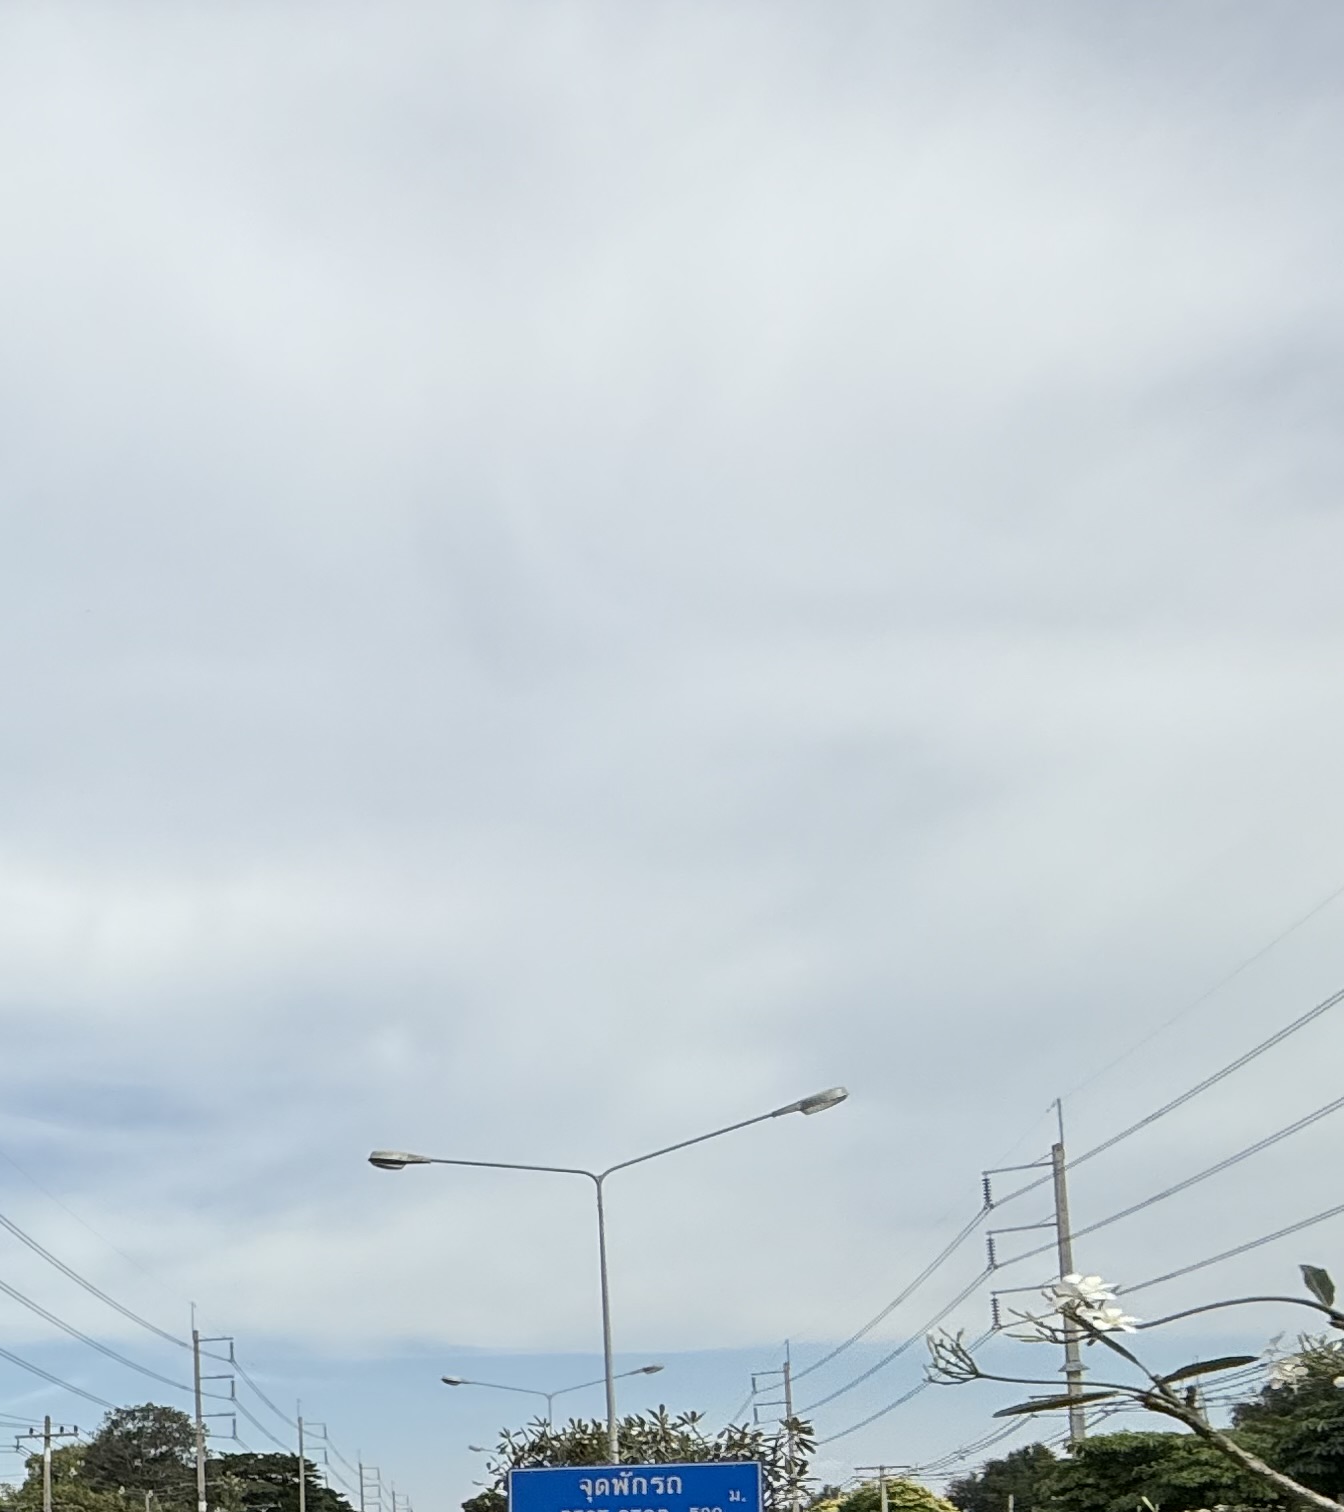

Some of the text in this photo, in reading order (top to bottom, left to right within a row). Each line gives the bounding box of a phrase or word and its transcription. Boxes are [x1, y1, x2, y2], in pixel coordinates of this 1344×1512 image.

[579, 1471, 682, 1503] จุดพักรถ
[729, 1489, 747, 1502] ม.
